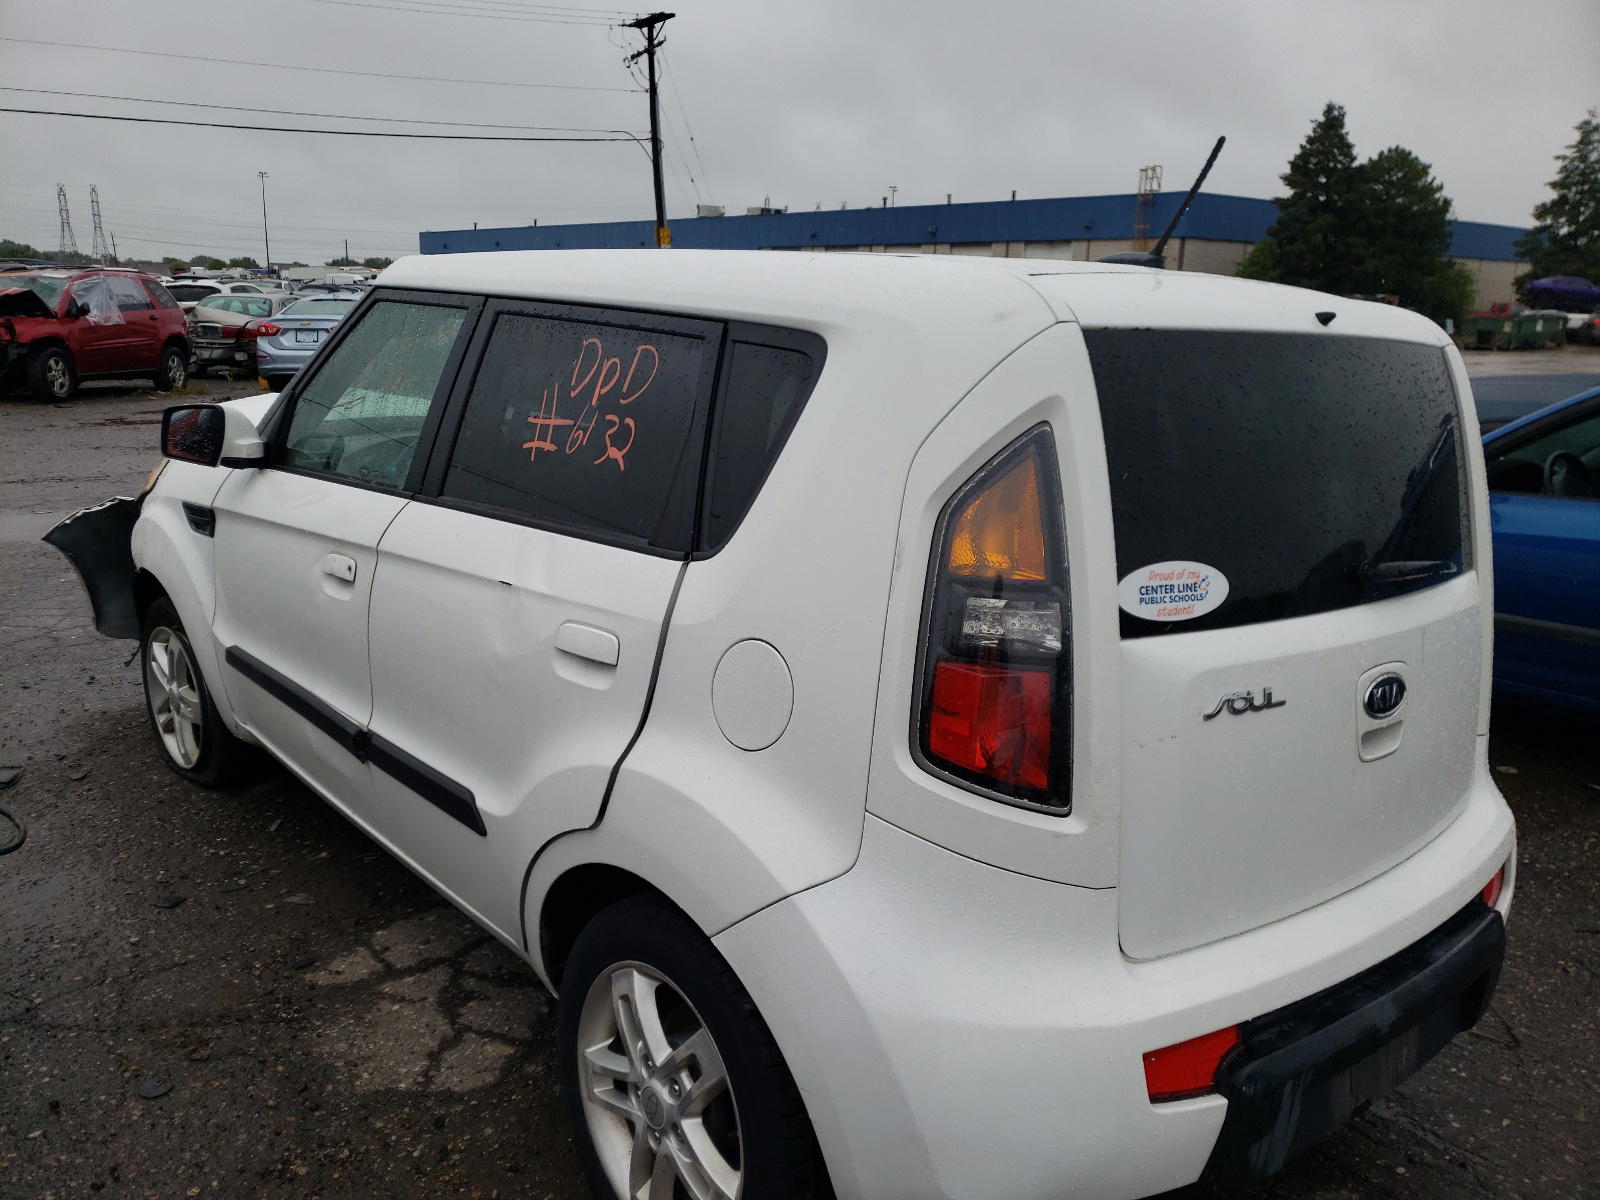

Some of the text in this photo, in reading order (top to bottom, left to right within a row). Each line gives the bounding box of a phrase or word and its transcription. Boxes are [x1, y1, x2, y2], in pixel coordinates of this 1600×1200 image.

[1149, 568, 1201, 582] Proud of my
[1139, 582, 1198, 596] CENTER LINE
[1139, 593, 1204, 605] PUBLIC SCHOOLS
[1372, 682, 1402, 710] KIA
